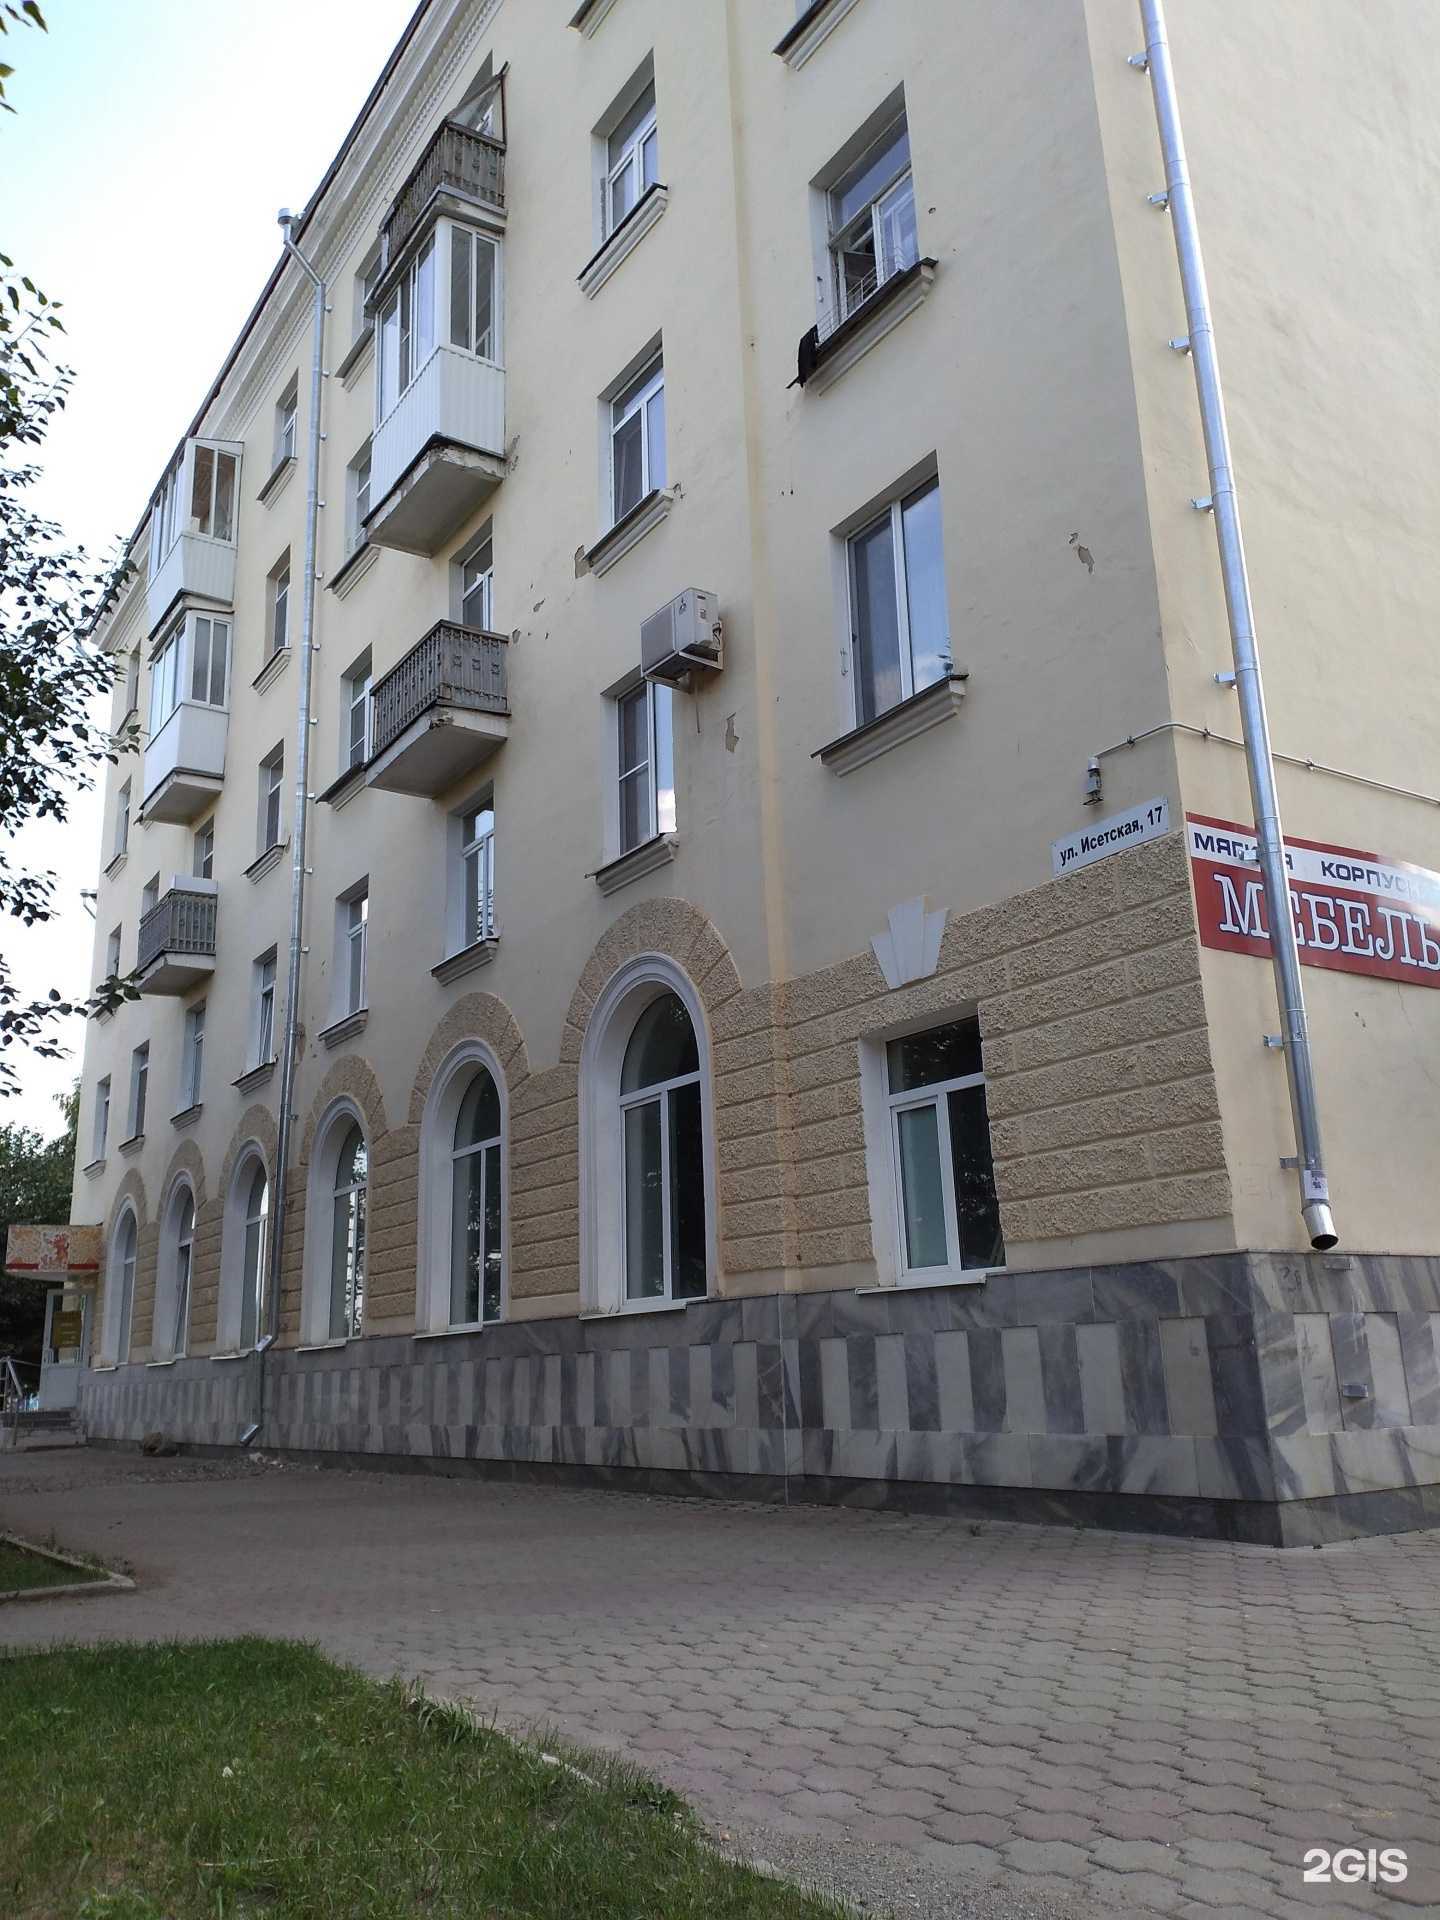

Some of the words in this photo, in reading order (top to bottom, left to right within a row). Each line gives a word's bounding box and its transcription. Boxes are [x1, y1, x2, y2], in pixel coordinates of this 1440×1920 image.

[1060, 847, 1078, 866] ул.
[1080, 820, 1144, 853] Исетская,
[1147, 806, 1163, 826] 17
